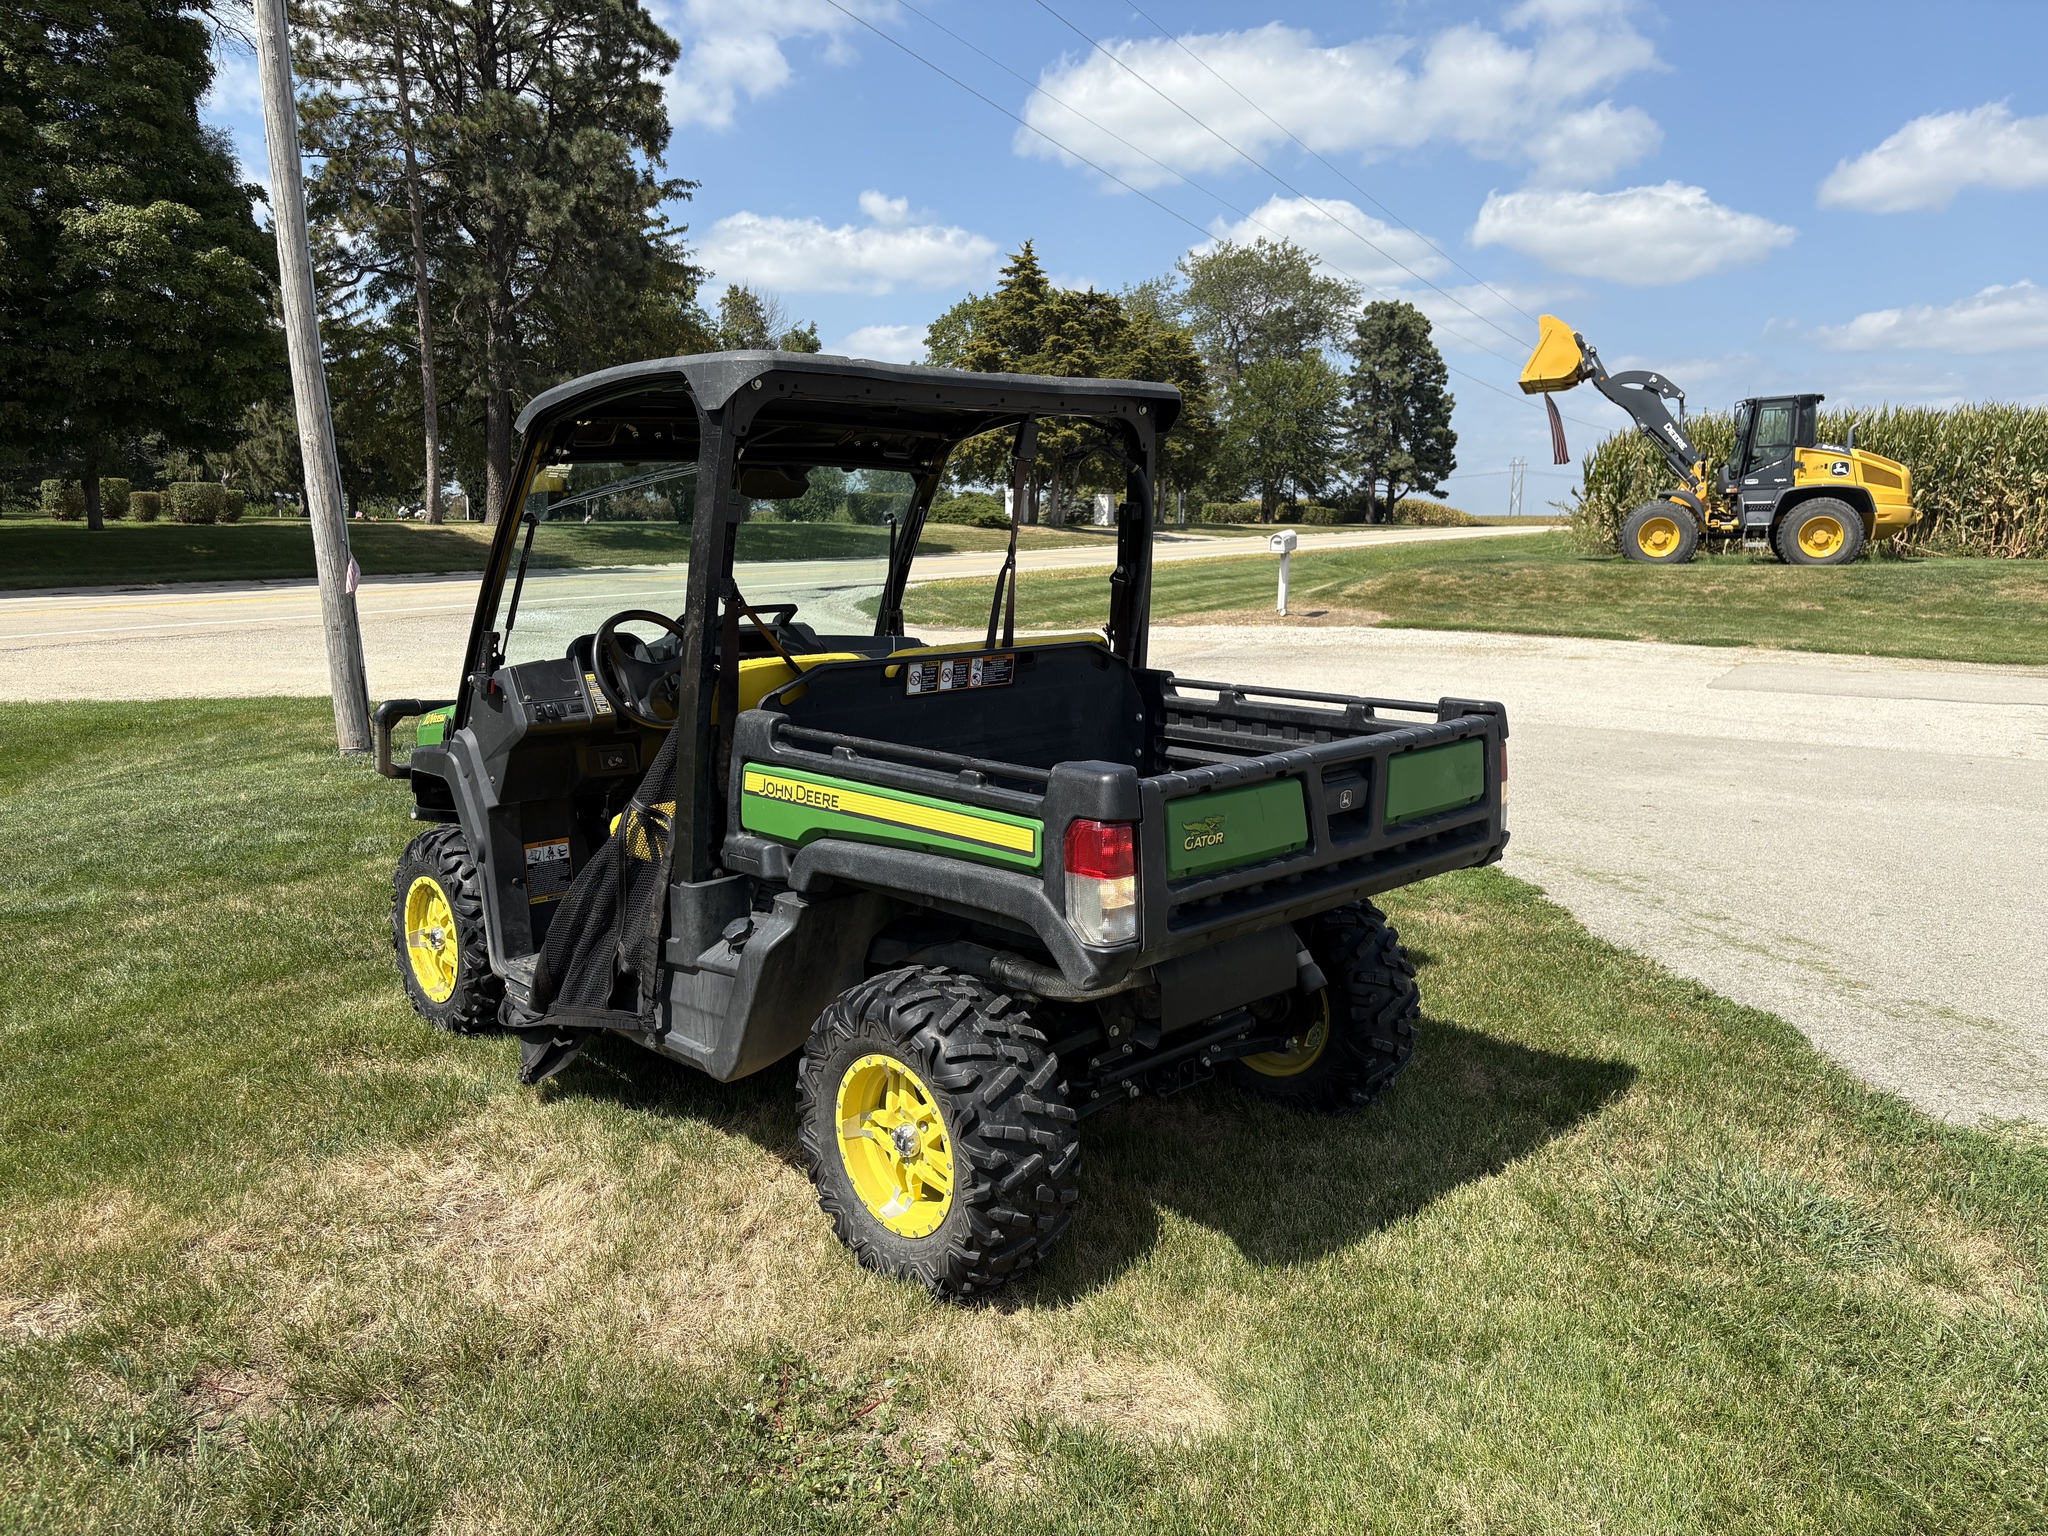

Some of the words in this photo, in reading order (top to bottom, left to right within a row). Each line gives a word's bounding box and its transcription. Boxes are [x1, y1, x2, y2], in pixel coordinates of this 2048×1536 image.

[1663, 422, 1687, 450] DEERE
[759, 778, 793, 799] JOHN
[796, 784, 840, 808] DEERE
[1184, 832, 1223, 850] GATOR
